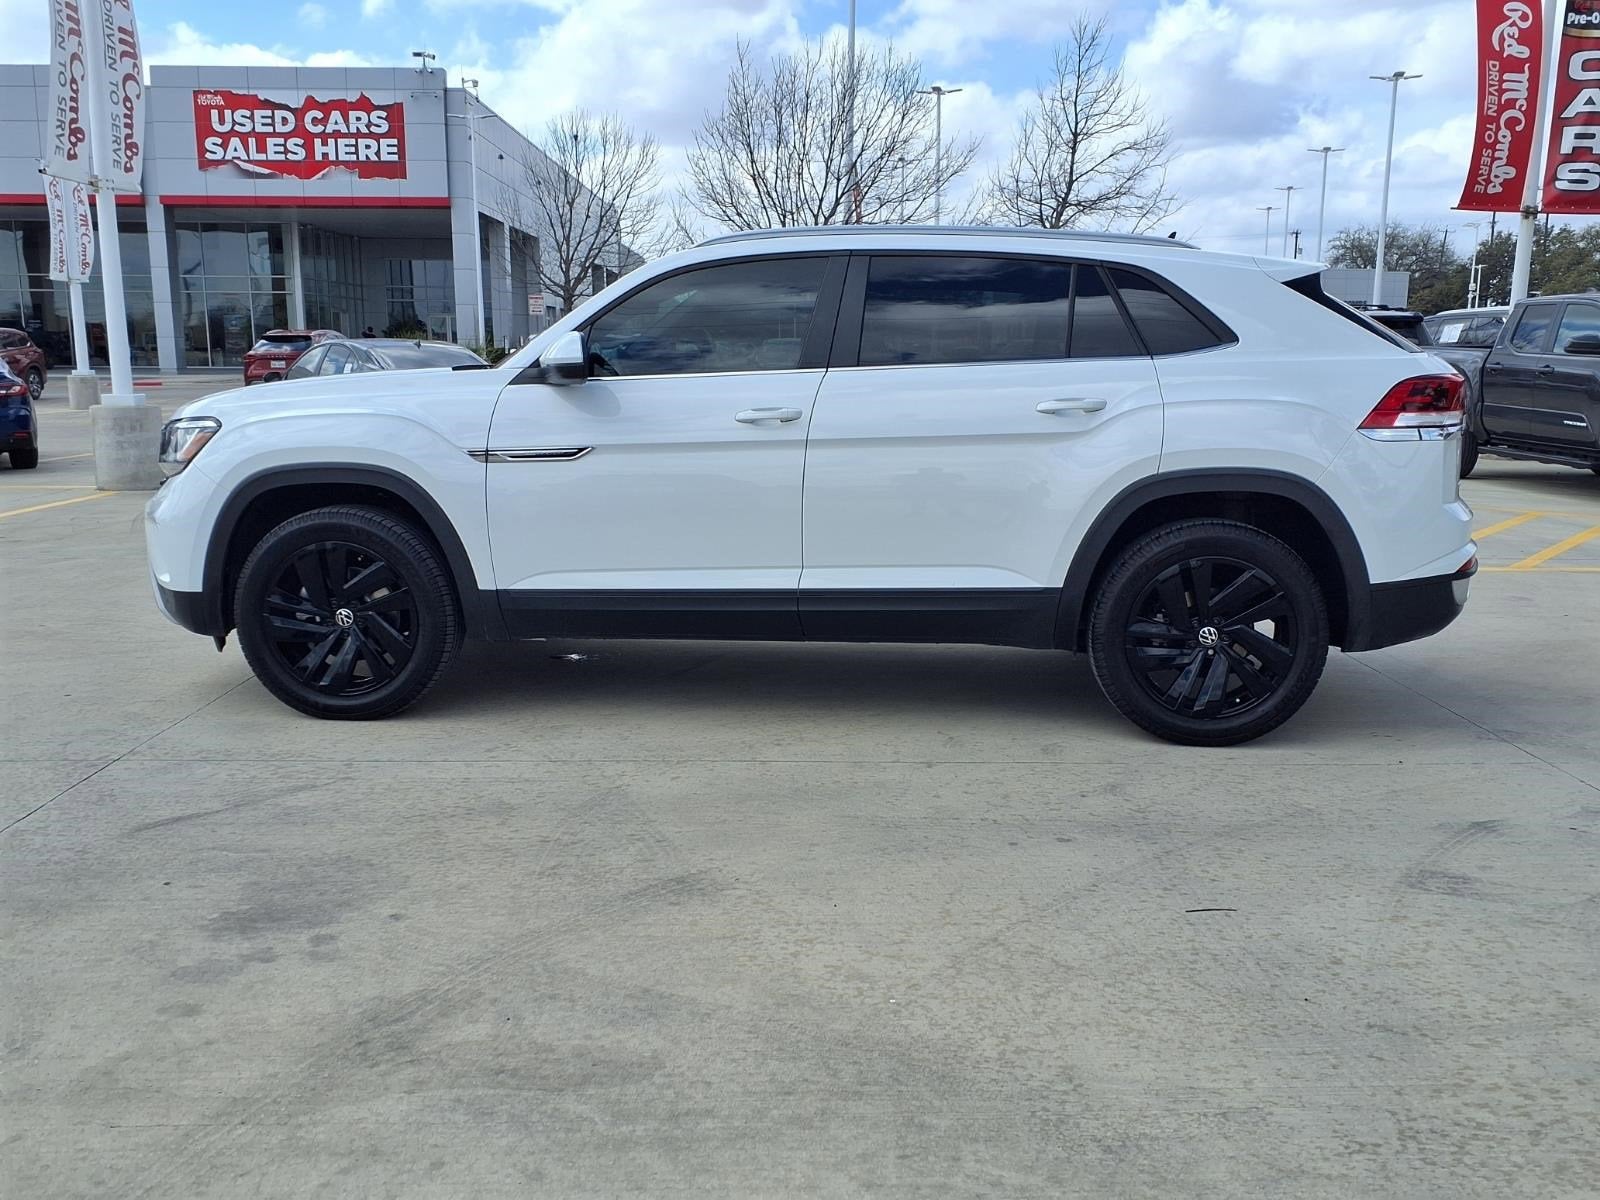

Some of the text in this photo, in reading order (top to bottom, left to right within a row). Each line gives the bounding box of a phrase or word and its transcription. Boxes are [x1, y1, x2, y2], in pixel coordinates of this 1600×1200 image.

[54, 0, 68, 156] IVEN TO SERVE
[103, 0, 123, 171] DRIVEN TO SERVE
[117, 19, 142, 175] McCombs
[204, 136, 399, 162] SALES HERE
[210, 109, 390, 134] USED CARS
[1474, 59, 1500, 194] DRIVEN TO SERVE
[1486, 1, 1533, 195] Red McCombs
